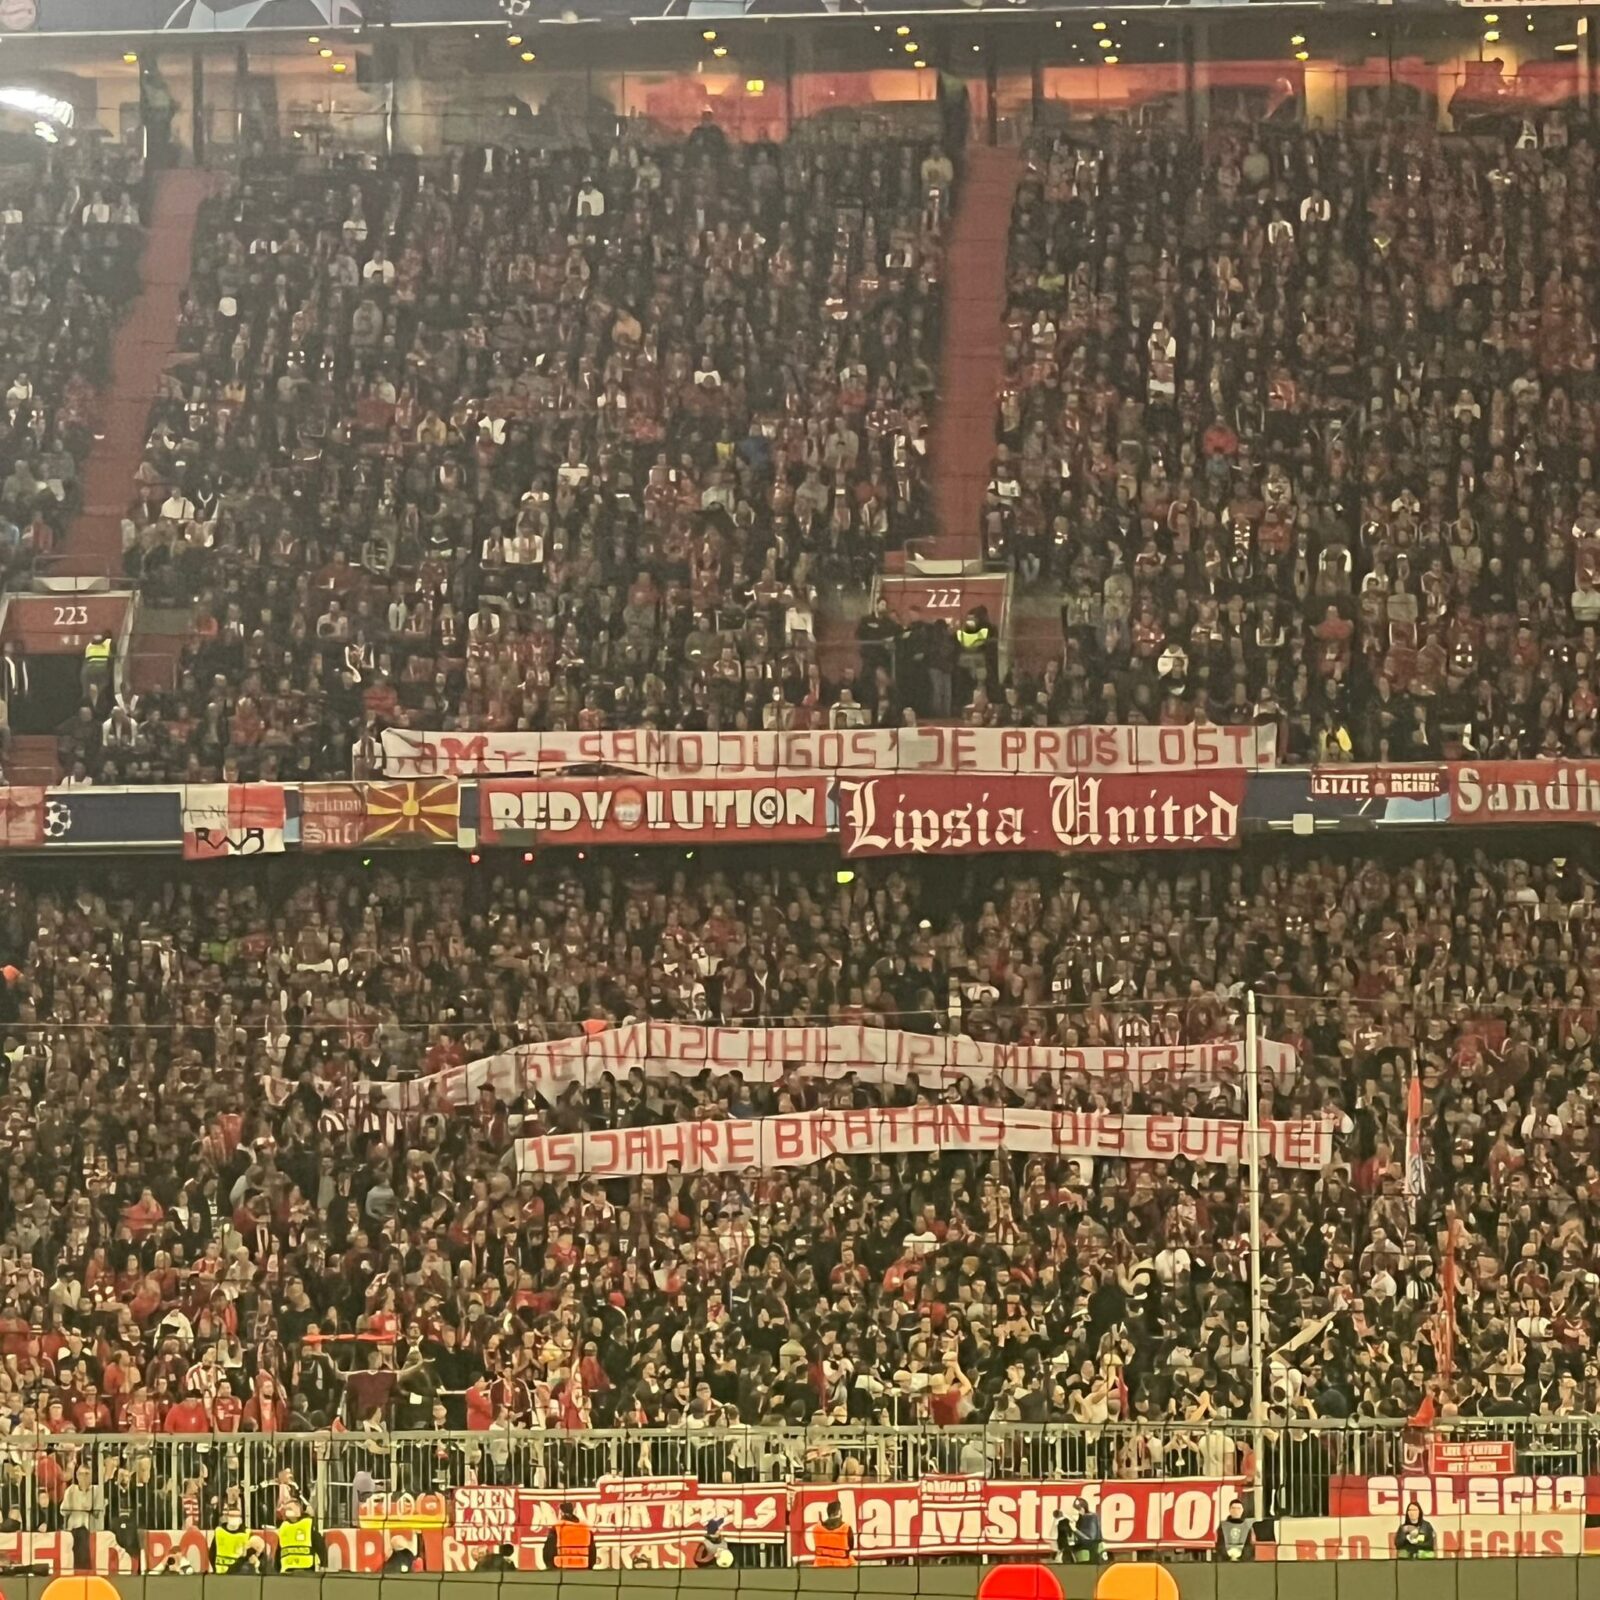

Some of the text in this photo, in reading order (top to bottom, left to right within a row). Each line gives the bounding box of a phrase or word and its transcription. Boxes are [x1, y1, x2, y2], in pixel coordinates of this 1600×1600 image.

[926, 588, 961, 609] 222
[53, 606, 88, 626] 223
[839, 775, 1239, 854] Lipsia United
[529, 1136, 577, 1175] 15
[589, 1121, 755, 1174] JAHRE
[774, 1105, 1006, 1160] BRATANS
[1051, 1110, 1126, 1150] DIS
[455, 1488, 516, 1509] SEEN
[455, 1508, 516, 1527] LAND
[455, 1526, 515, 1543] FRONT
